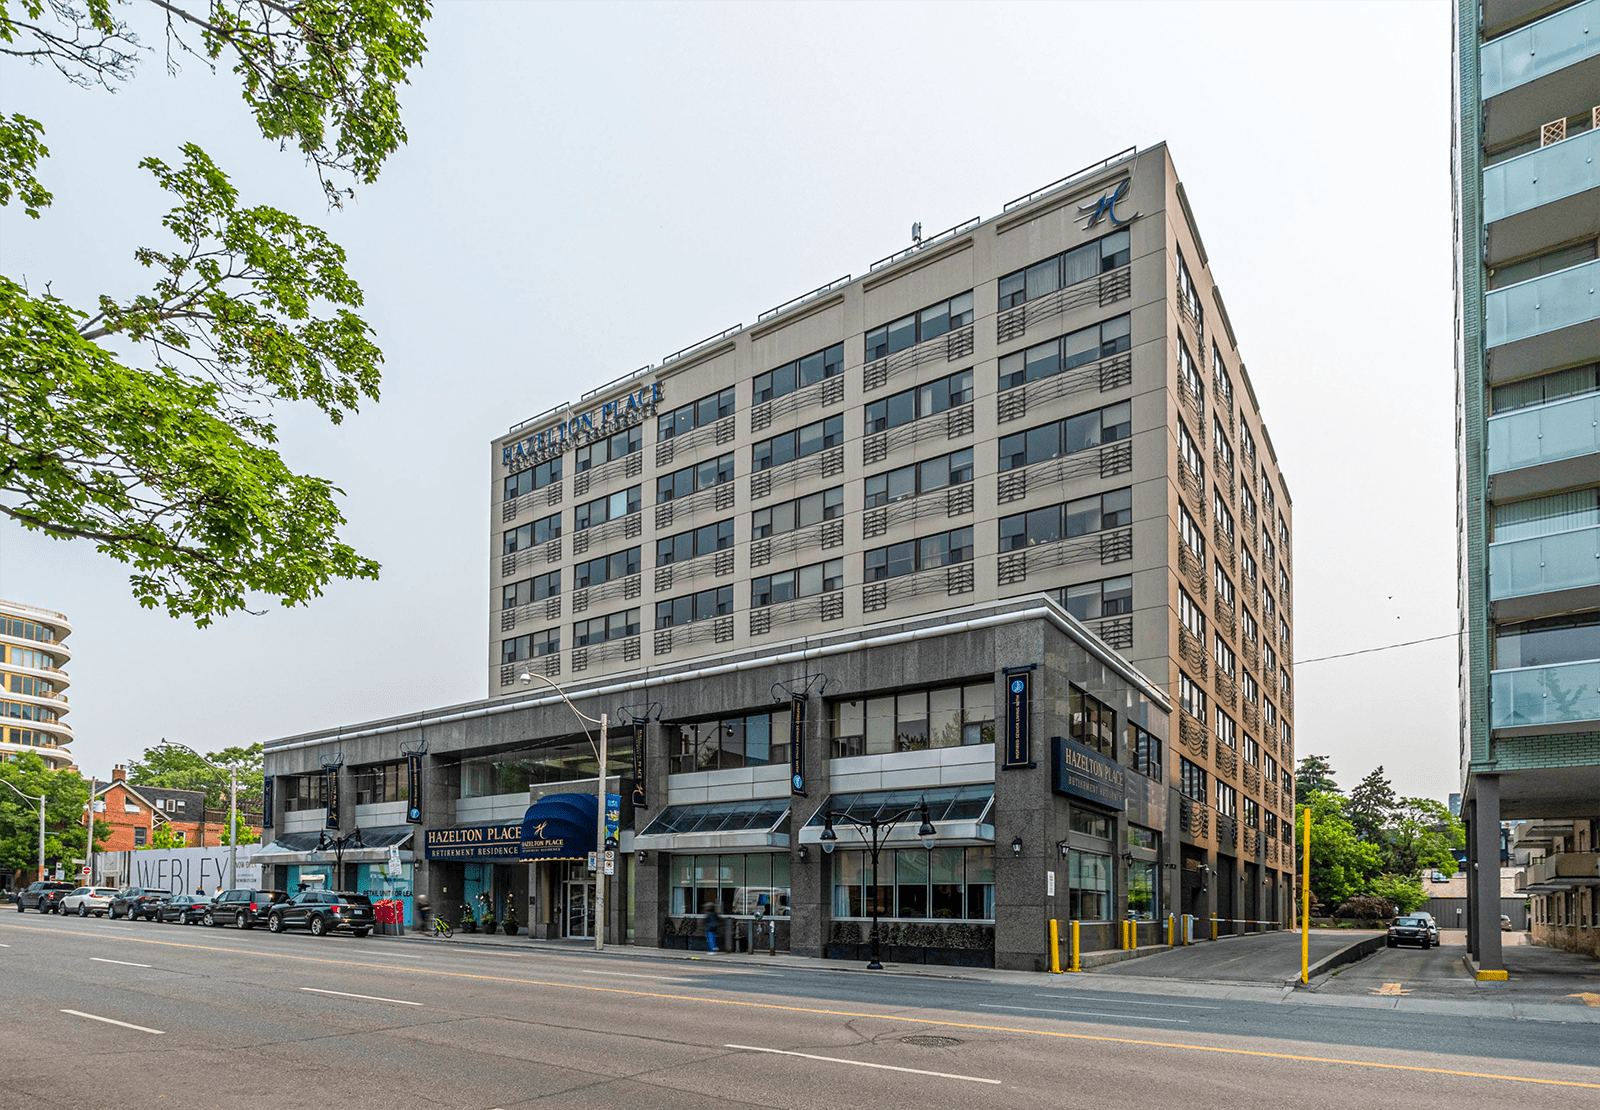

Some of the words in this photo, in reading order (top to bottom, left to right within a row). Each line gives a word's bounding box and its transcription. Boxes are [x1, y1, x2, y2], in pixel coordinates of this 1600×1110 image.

[502, 410, 595, 465] HAZELTON
[602, 380, 665, 421] PLACE
[1065, 747, 1103, 778] HAZELTON
[1104, 765, 1124, 787] PLACE
[428, 828, 482, 843] HAZELTON
[487, 826, 522, 841] PLACE
[545, 838, 564, 846] PLACE
[431, 848, 474, 857] RETIREMENT
[477, 846, 518, 856] RESIDENCE
[137, 857, 229, 895] WEBLEY
